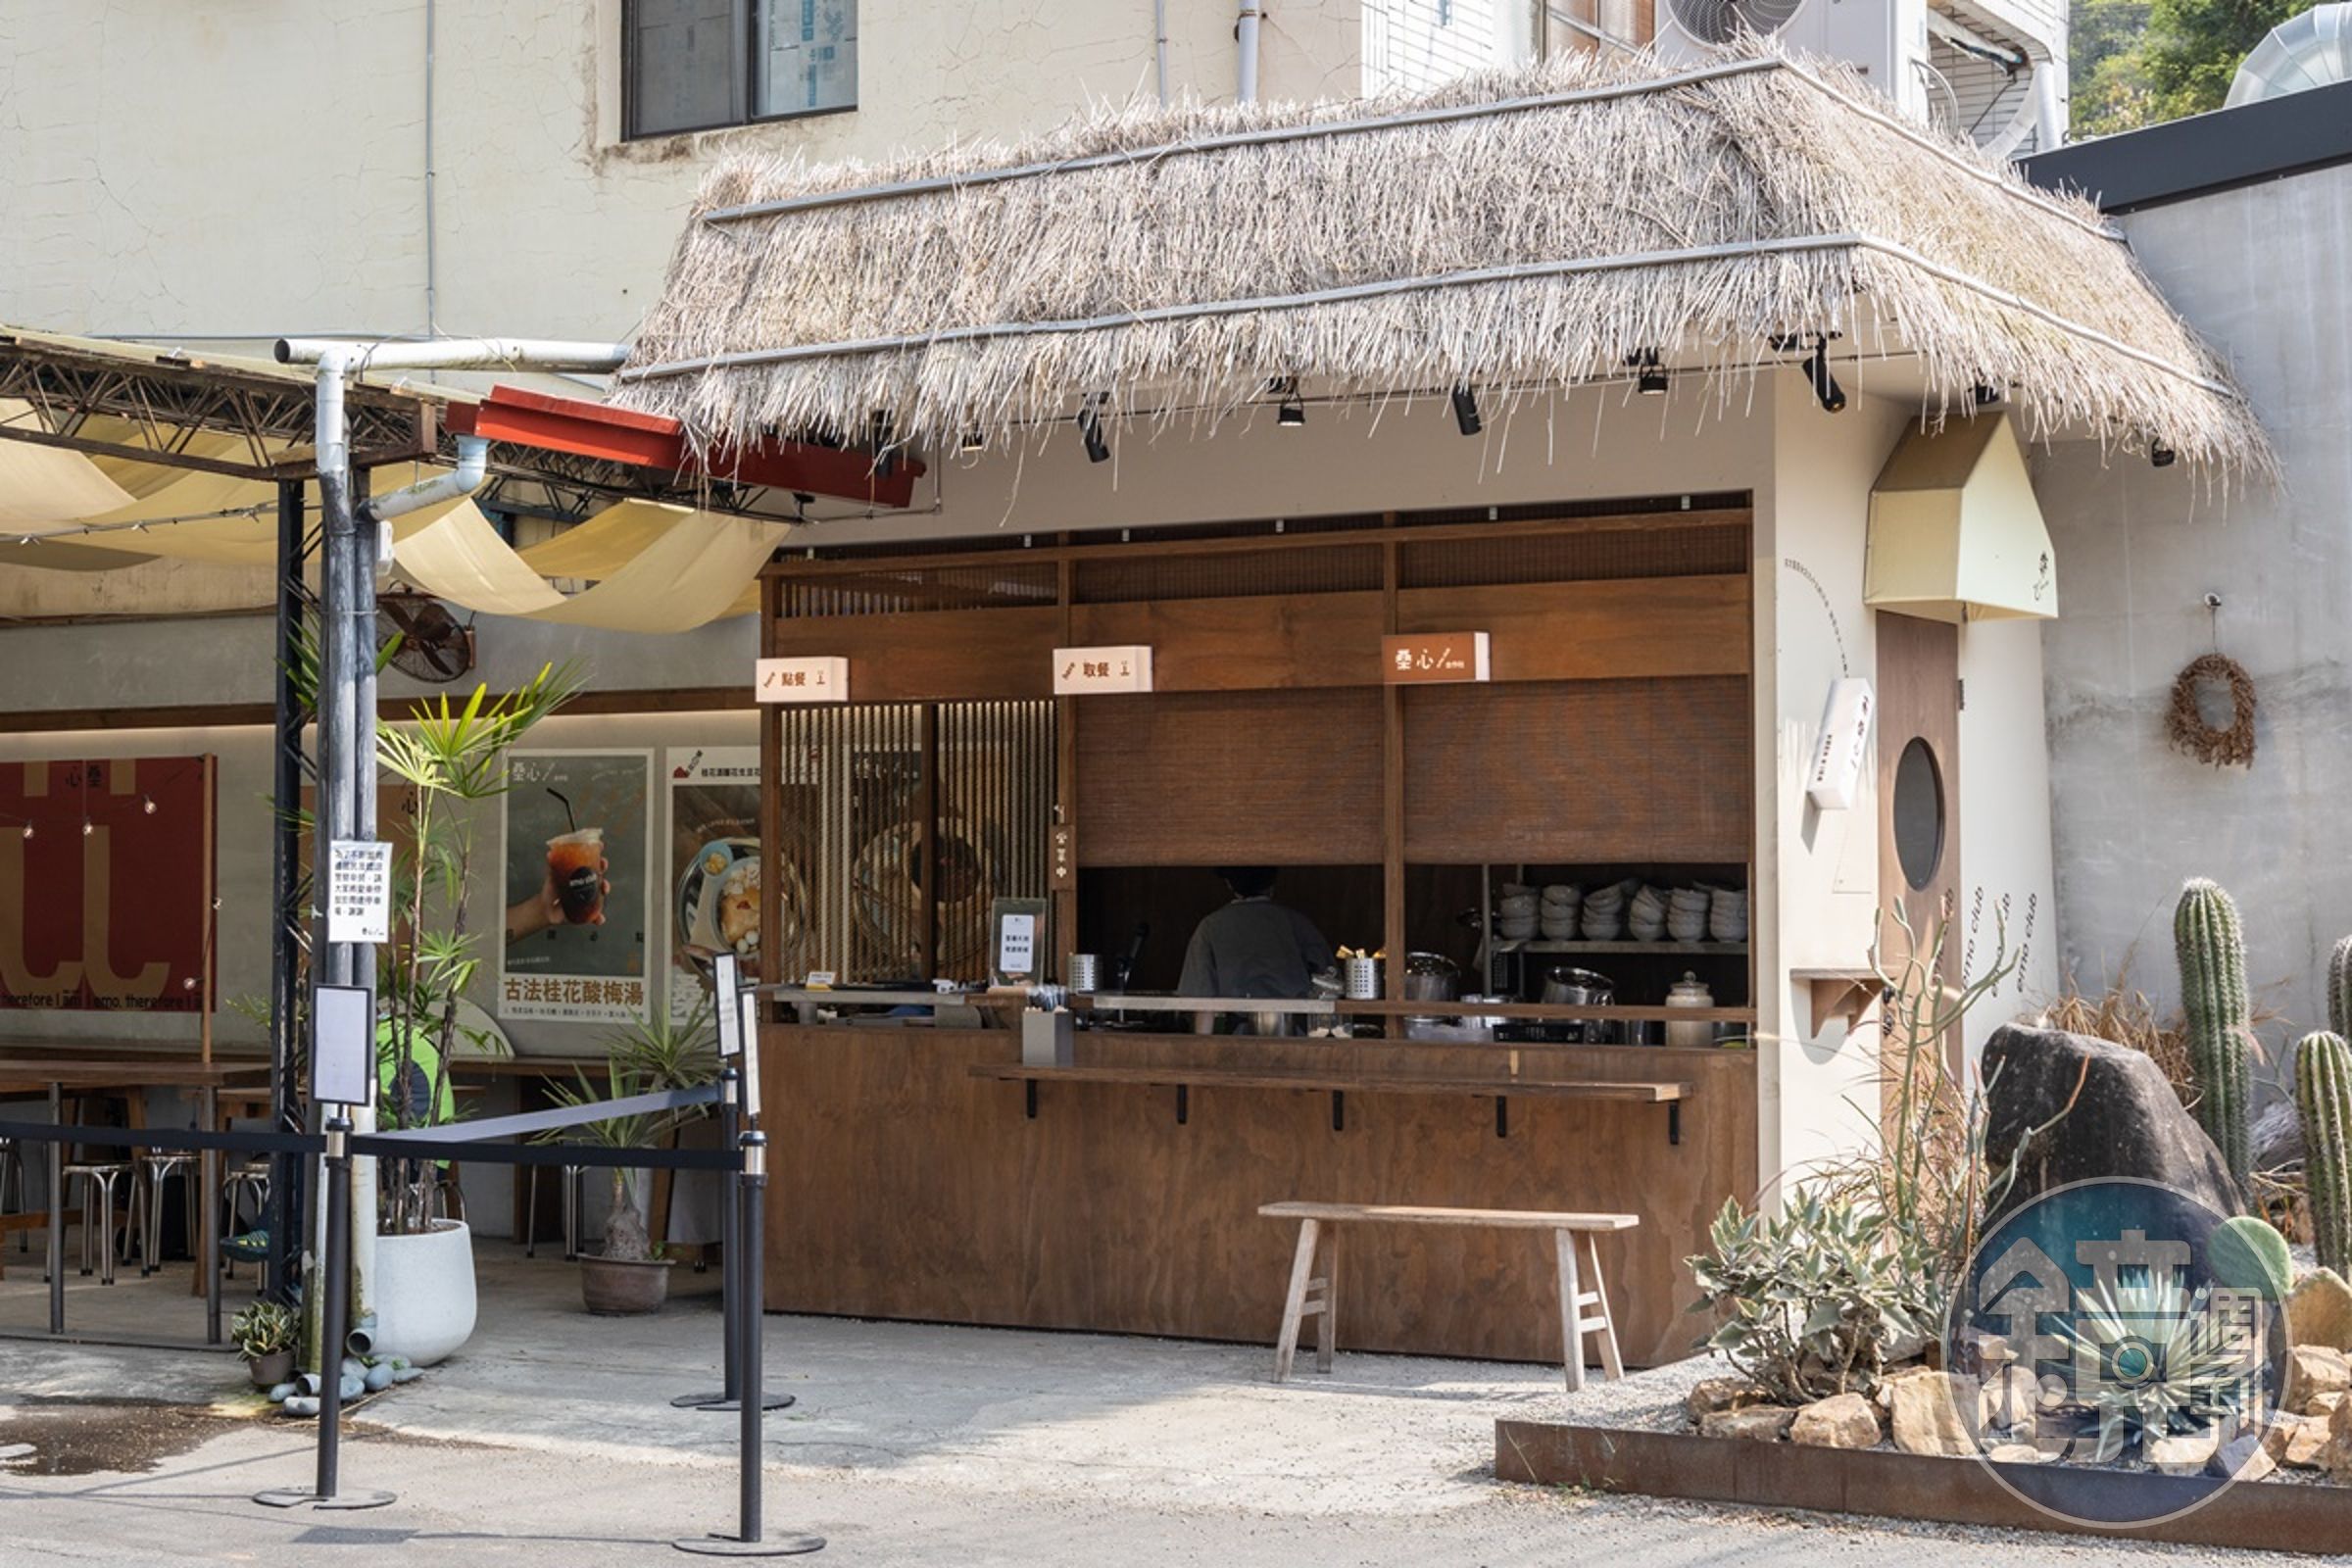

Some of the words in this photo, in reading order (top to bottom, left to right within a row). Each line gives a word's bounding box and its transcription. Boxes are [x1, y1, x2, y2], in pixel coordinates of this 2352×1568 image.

[504, 978, 644, 1005] 古法桂花酸梅湯
